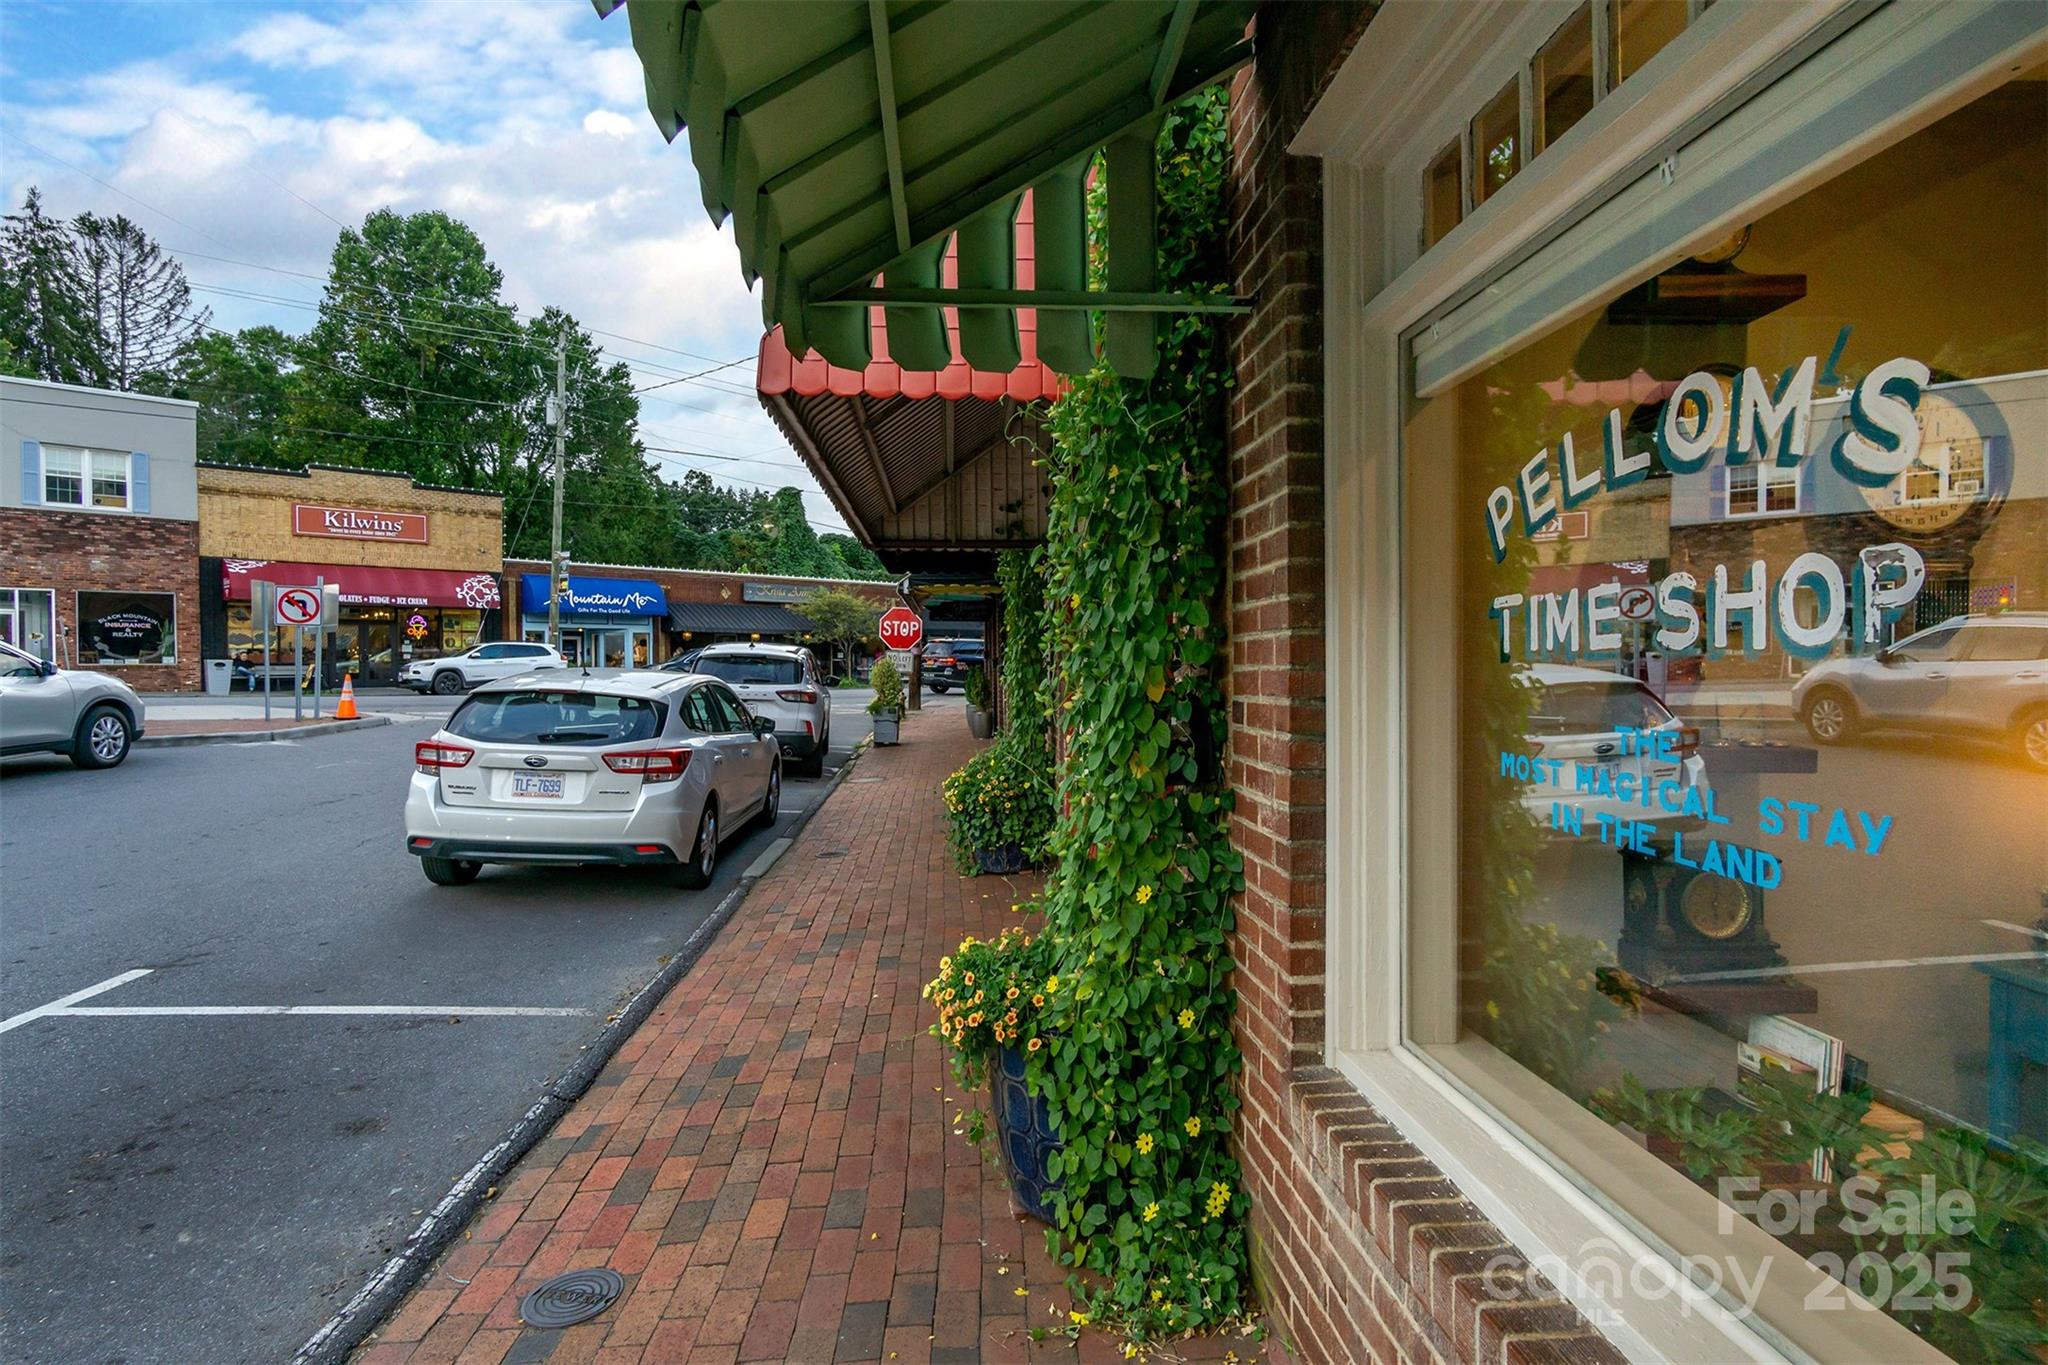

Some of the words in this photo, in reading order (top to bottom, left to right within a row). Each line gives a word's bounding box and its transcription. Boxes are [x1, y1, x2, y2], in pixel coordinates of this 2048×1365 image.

[1486, 326, 1932, 563] PELLOM'S
[324, 511, 402, 532] Kilwins
[339, 595, 363, 603] OLATES
[369, 596, 390, 604] FUDGE
[396, 597, 407, 605] ICE
[407, 597, 428, 606] CREAM
[544, 590, 623, 607] Mountain
[1489, 582, 1624, 661] TIME
[1654, 543, 1926, 661] SHOP
[98, 613, 121, 624] BLACK
[122, 613, 159, 625] MOUNTAIN
[883, 620, 919, 636] STOP
[1614, 725, 1681, 763] THE
[514, 778, 562, 792] TLF-7699
[1501, 752, 1564, 787] MOST
[1576, 766, 1729, 825] MAGICAL
[1759, 797, 1893, 856] STAY
[1552, 802, 1583, 837] IN
[1596, 814, 1657, 857] THE
[1674, 831, 1783, 891] LAND
